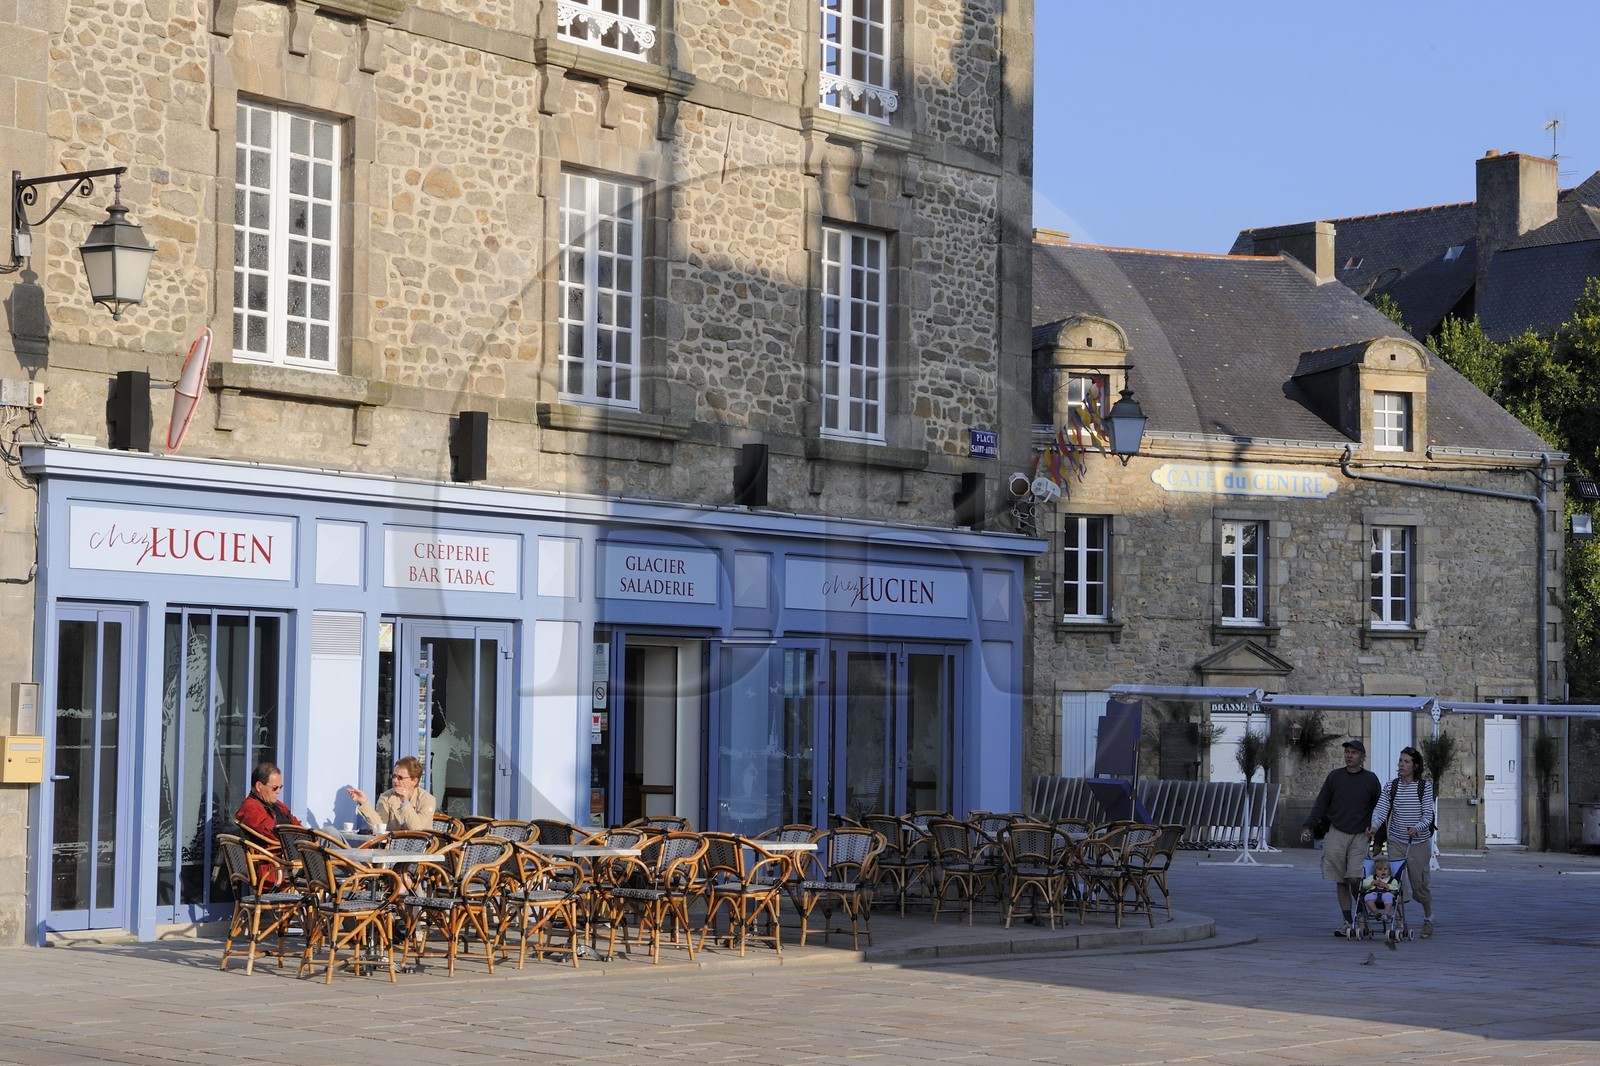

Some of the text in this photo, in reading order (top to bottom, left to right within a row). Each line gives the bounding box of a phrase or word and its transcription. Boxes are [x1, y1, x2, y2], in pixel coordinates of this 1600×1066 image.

[976, 434, 994, 443] PLACE
[1166, 469, 1324, 494] CAFE du CENTRE
[90, 523, 274, 565] chez LUCIEN
[414, 540, 490, 562] CRÈPERIE
[625, 555, 686, 574] GLACIER
[409, 566, 495, 585] BAR TABAC
[620, 577, 694, 597] SALADERIE
[822, 575, 935, 607] chez LUCIEN
